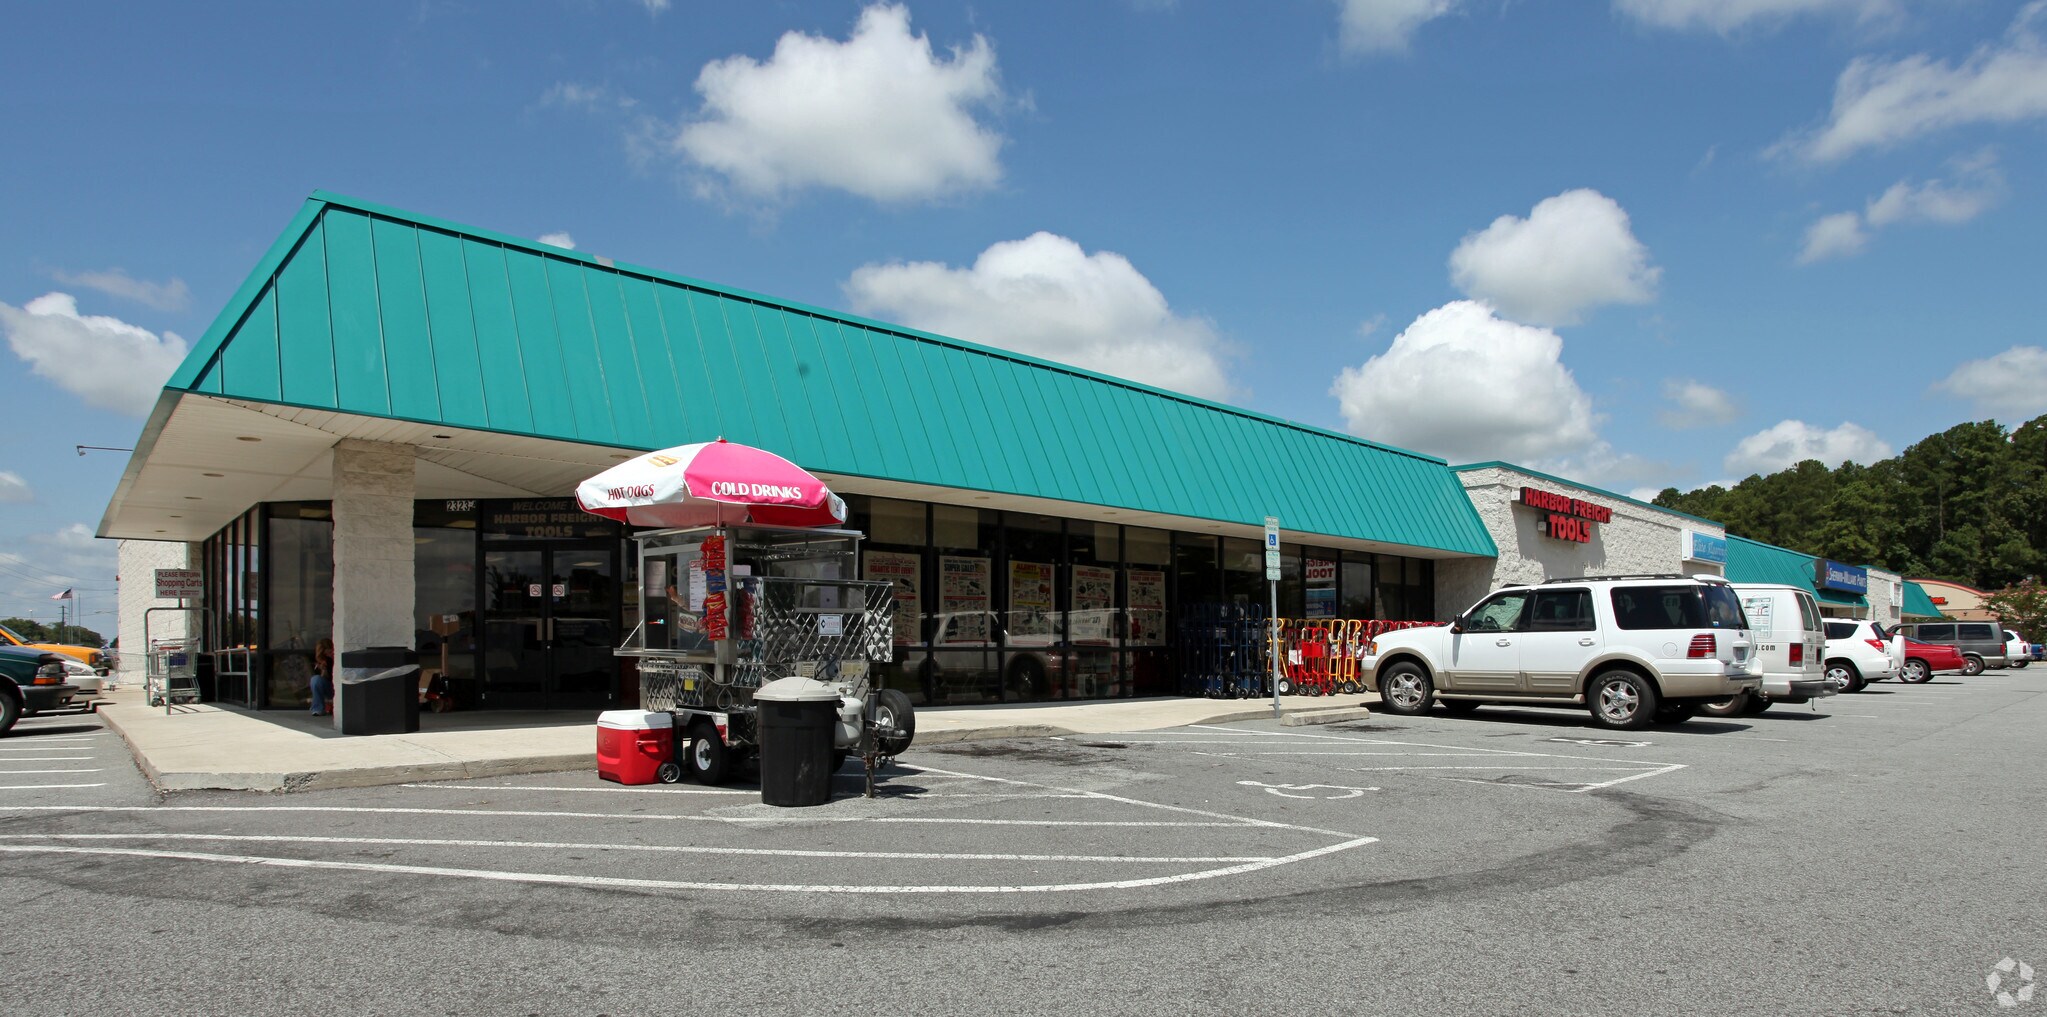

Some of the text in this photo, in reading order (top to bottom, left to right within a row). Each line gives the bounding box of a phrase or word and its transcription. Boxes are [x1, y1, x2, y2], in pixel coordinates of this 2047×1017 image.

[607, 484, 655, 501] HOT DOGS
[711, 481, 802, 499] COLD DRINKS
[512, 501, 568, 511] WELCOME
[1525, 487, 1613, 524] HARBOR FREIGHT
[494, 513, 604, 524] HARBOR FREIGHT
[525, 526, 574, 537] TOOLS
[1549, 514, 1591, 543] TOOLS
[157, 578, 203, 588] Shopping Carts
